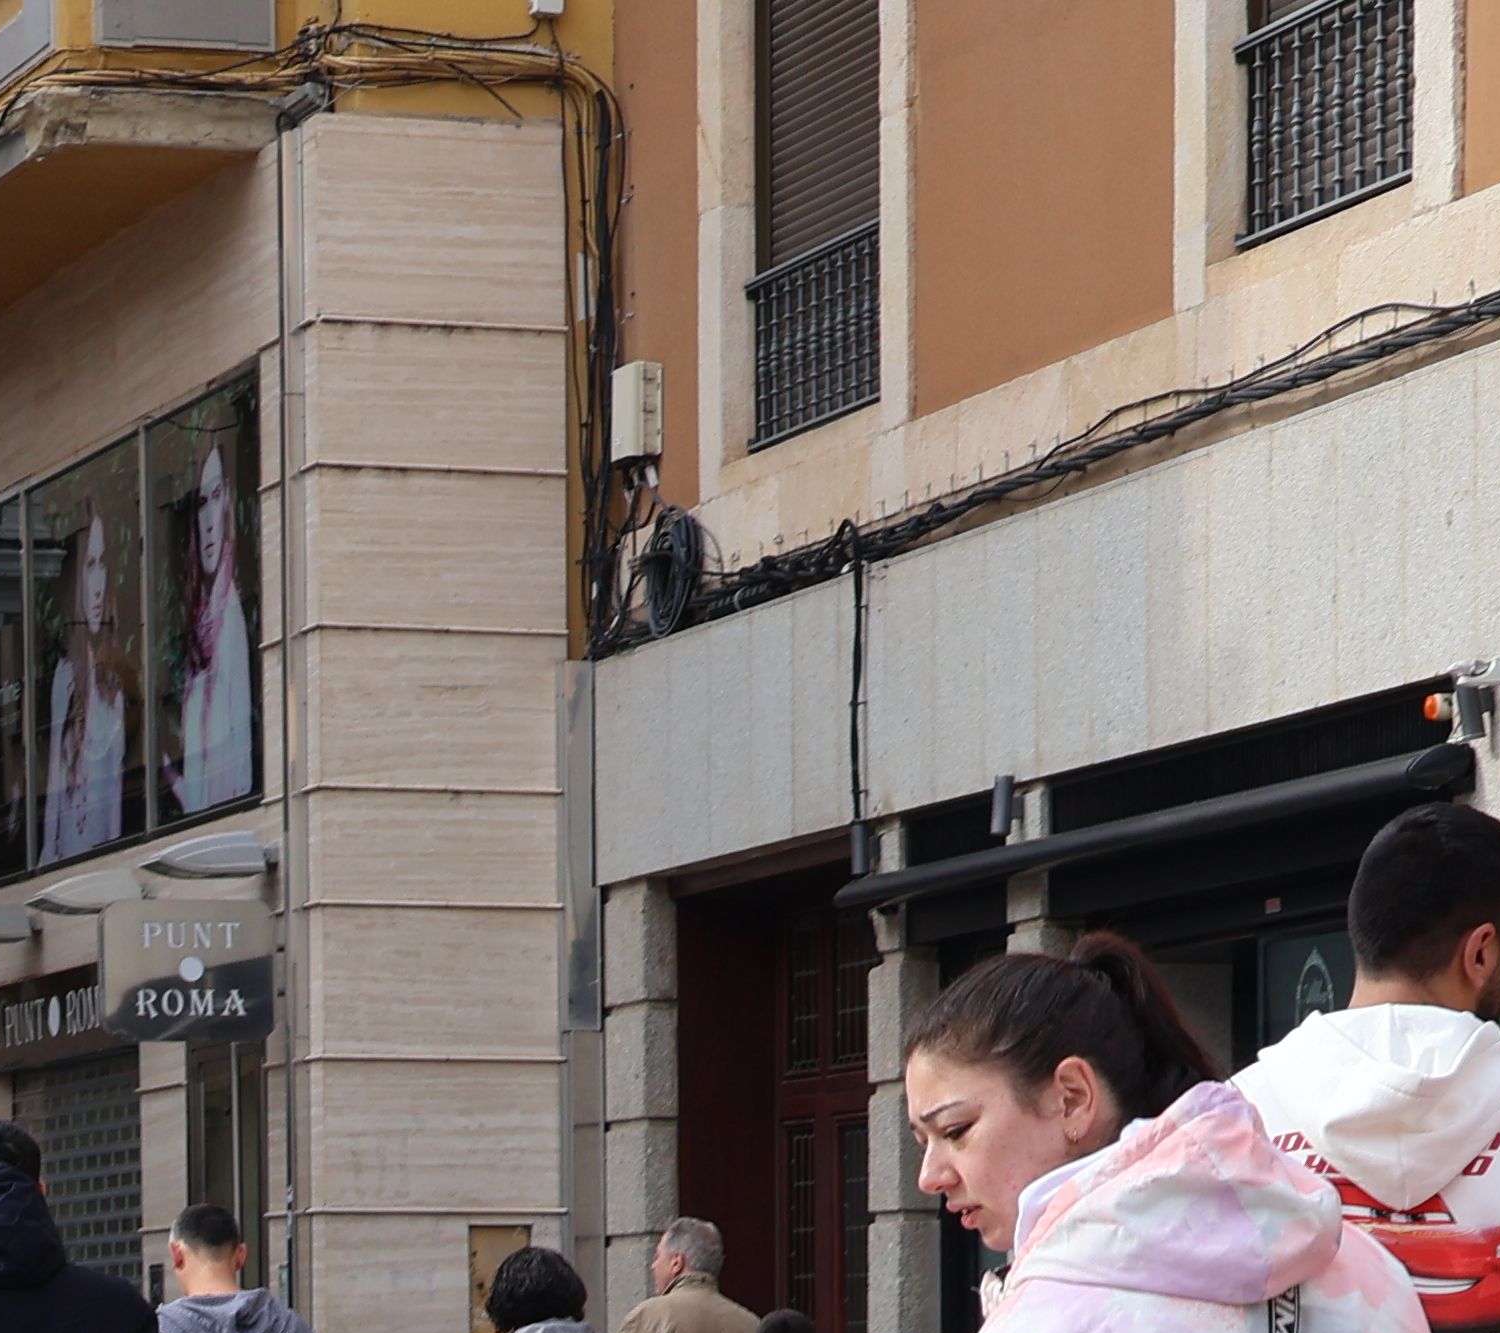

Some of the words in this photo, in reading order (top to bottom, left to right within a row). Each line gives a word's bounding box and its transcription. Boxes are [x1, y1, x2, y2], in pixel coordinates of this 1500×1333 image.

[142, 921, 241, 949] PUNT
[135, 988, 248, 1019] ROMA
[4, 998, 46, 1048] PUNT
